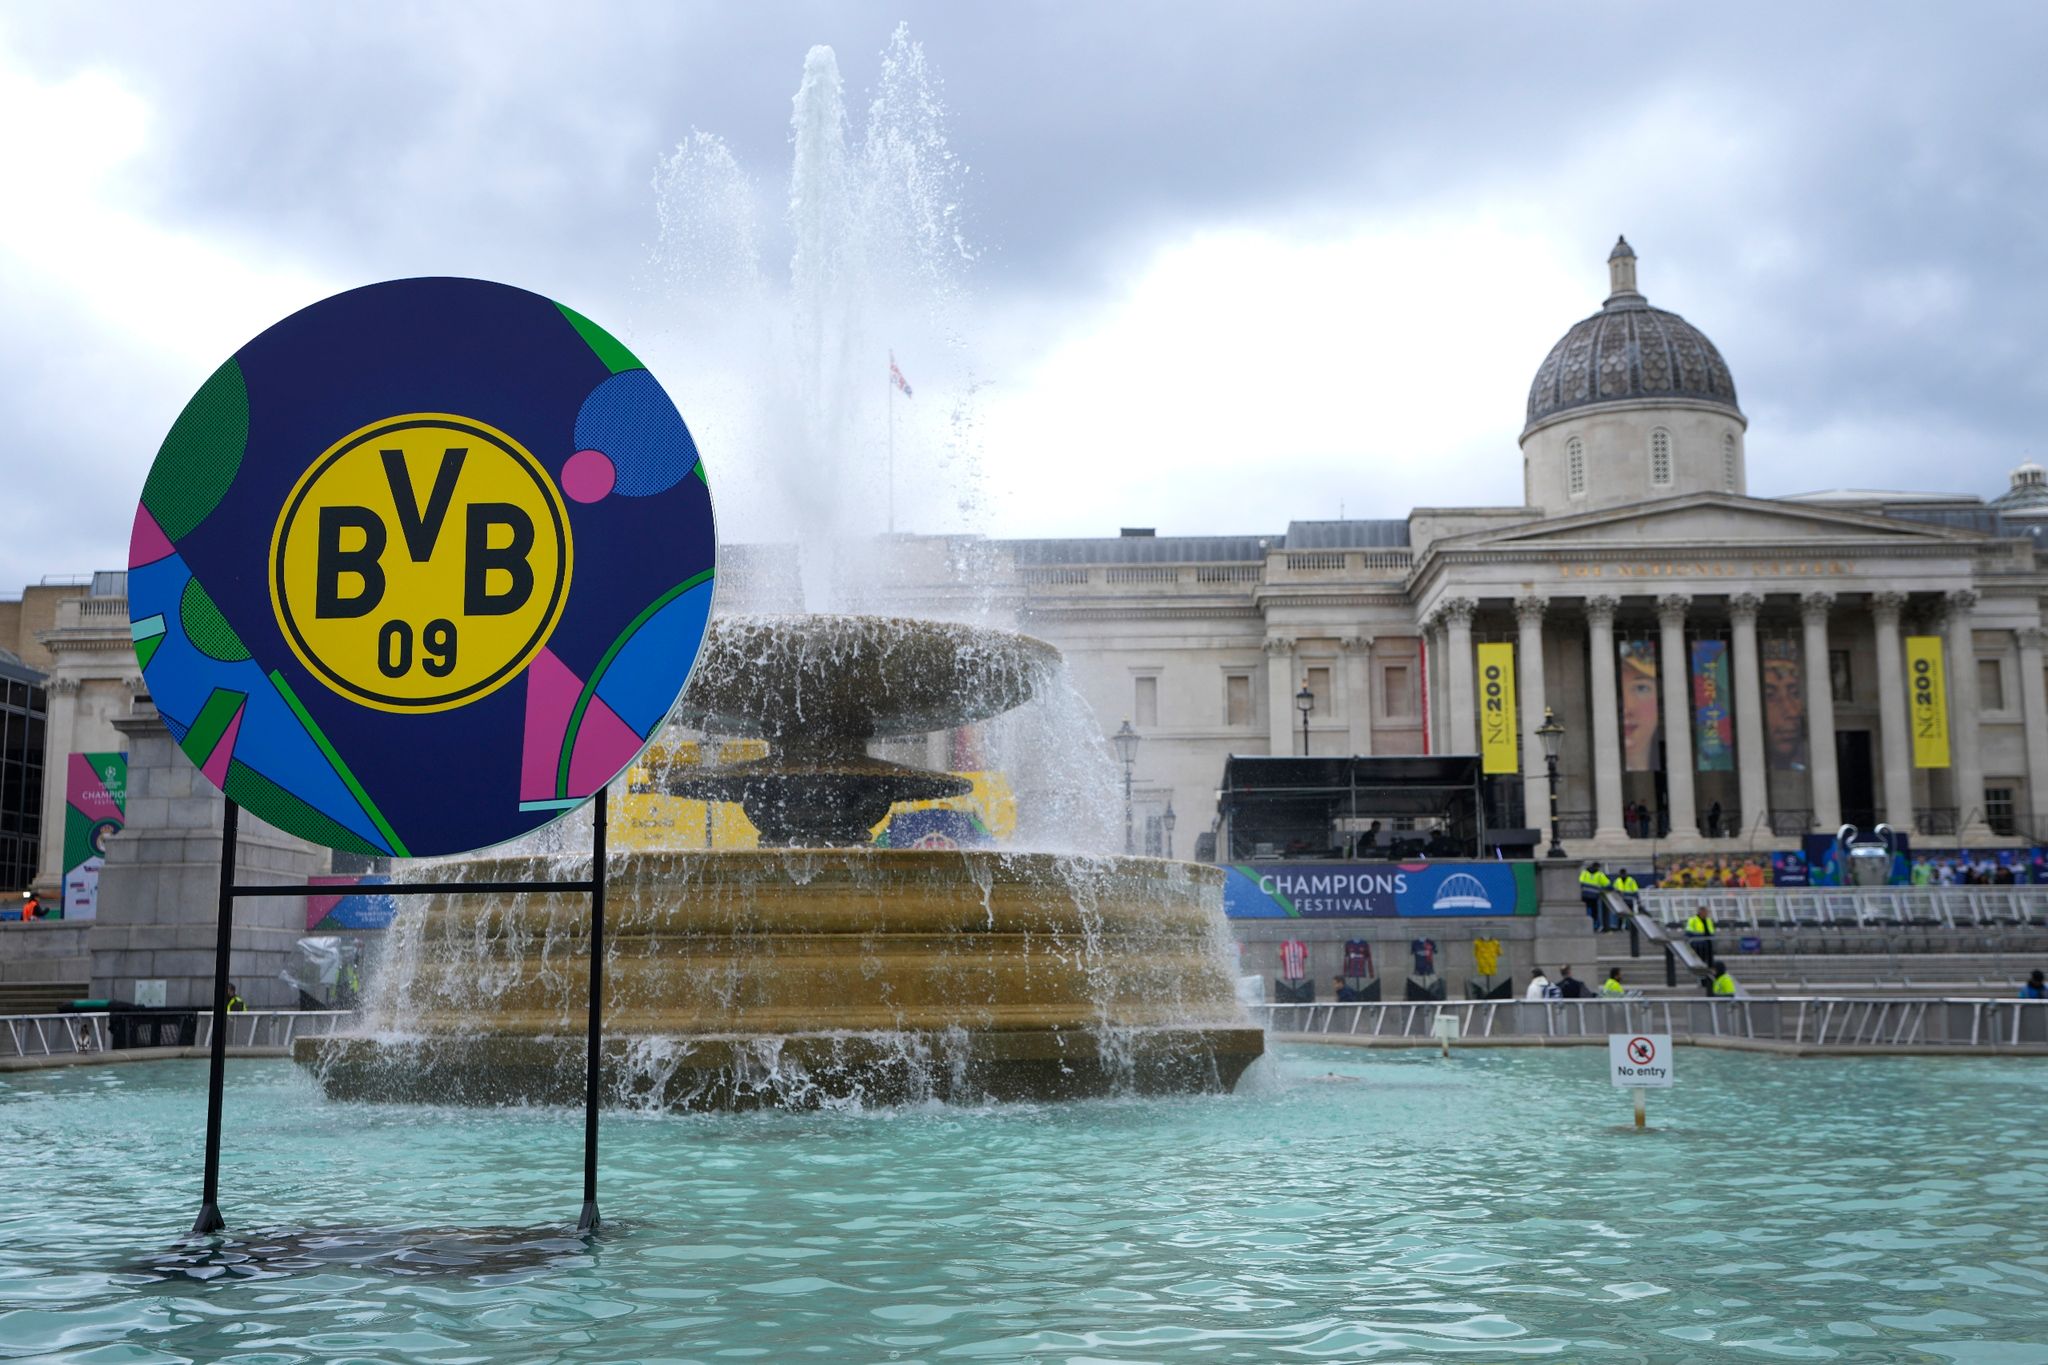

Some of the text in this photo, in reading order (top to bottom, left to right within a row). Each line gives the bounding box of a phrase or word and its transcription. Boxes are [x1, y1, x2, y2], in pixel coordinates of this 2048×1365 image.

[315, 448, 535, 619] BVB
[378, 618, 457, 679] 09
[1485, 664, 1505, 745] NG200
[1914, 658, 1935, 739] NG200
[1259, 873, 1408, 895] CHAMPIONS
[1295, 898, 1374, 912] FESTIVAL
[1618, 1066, 1666, 1079] No entry
